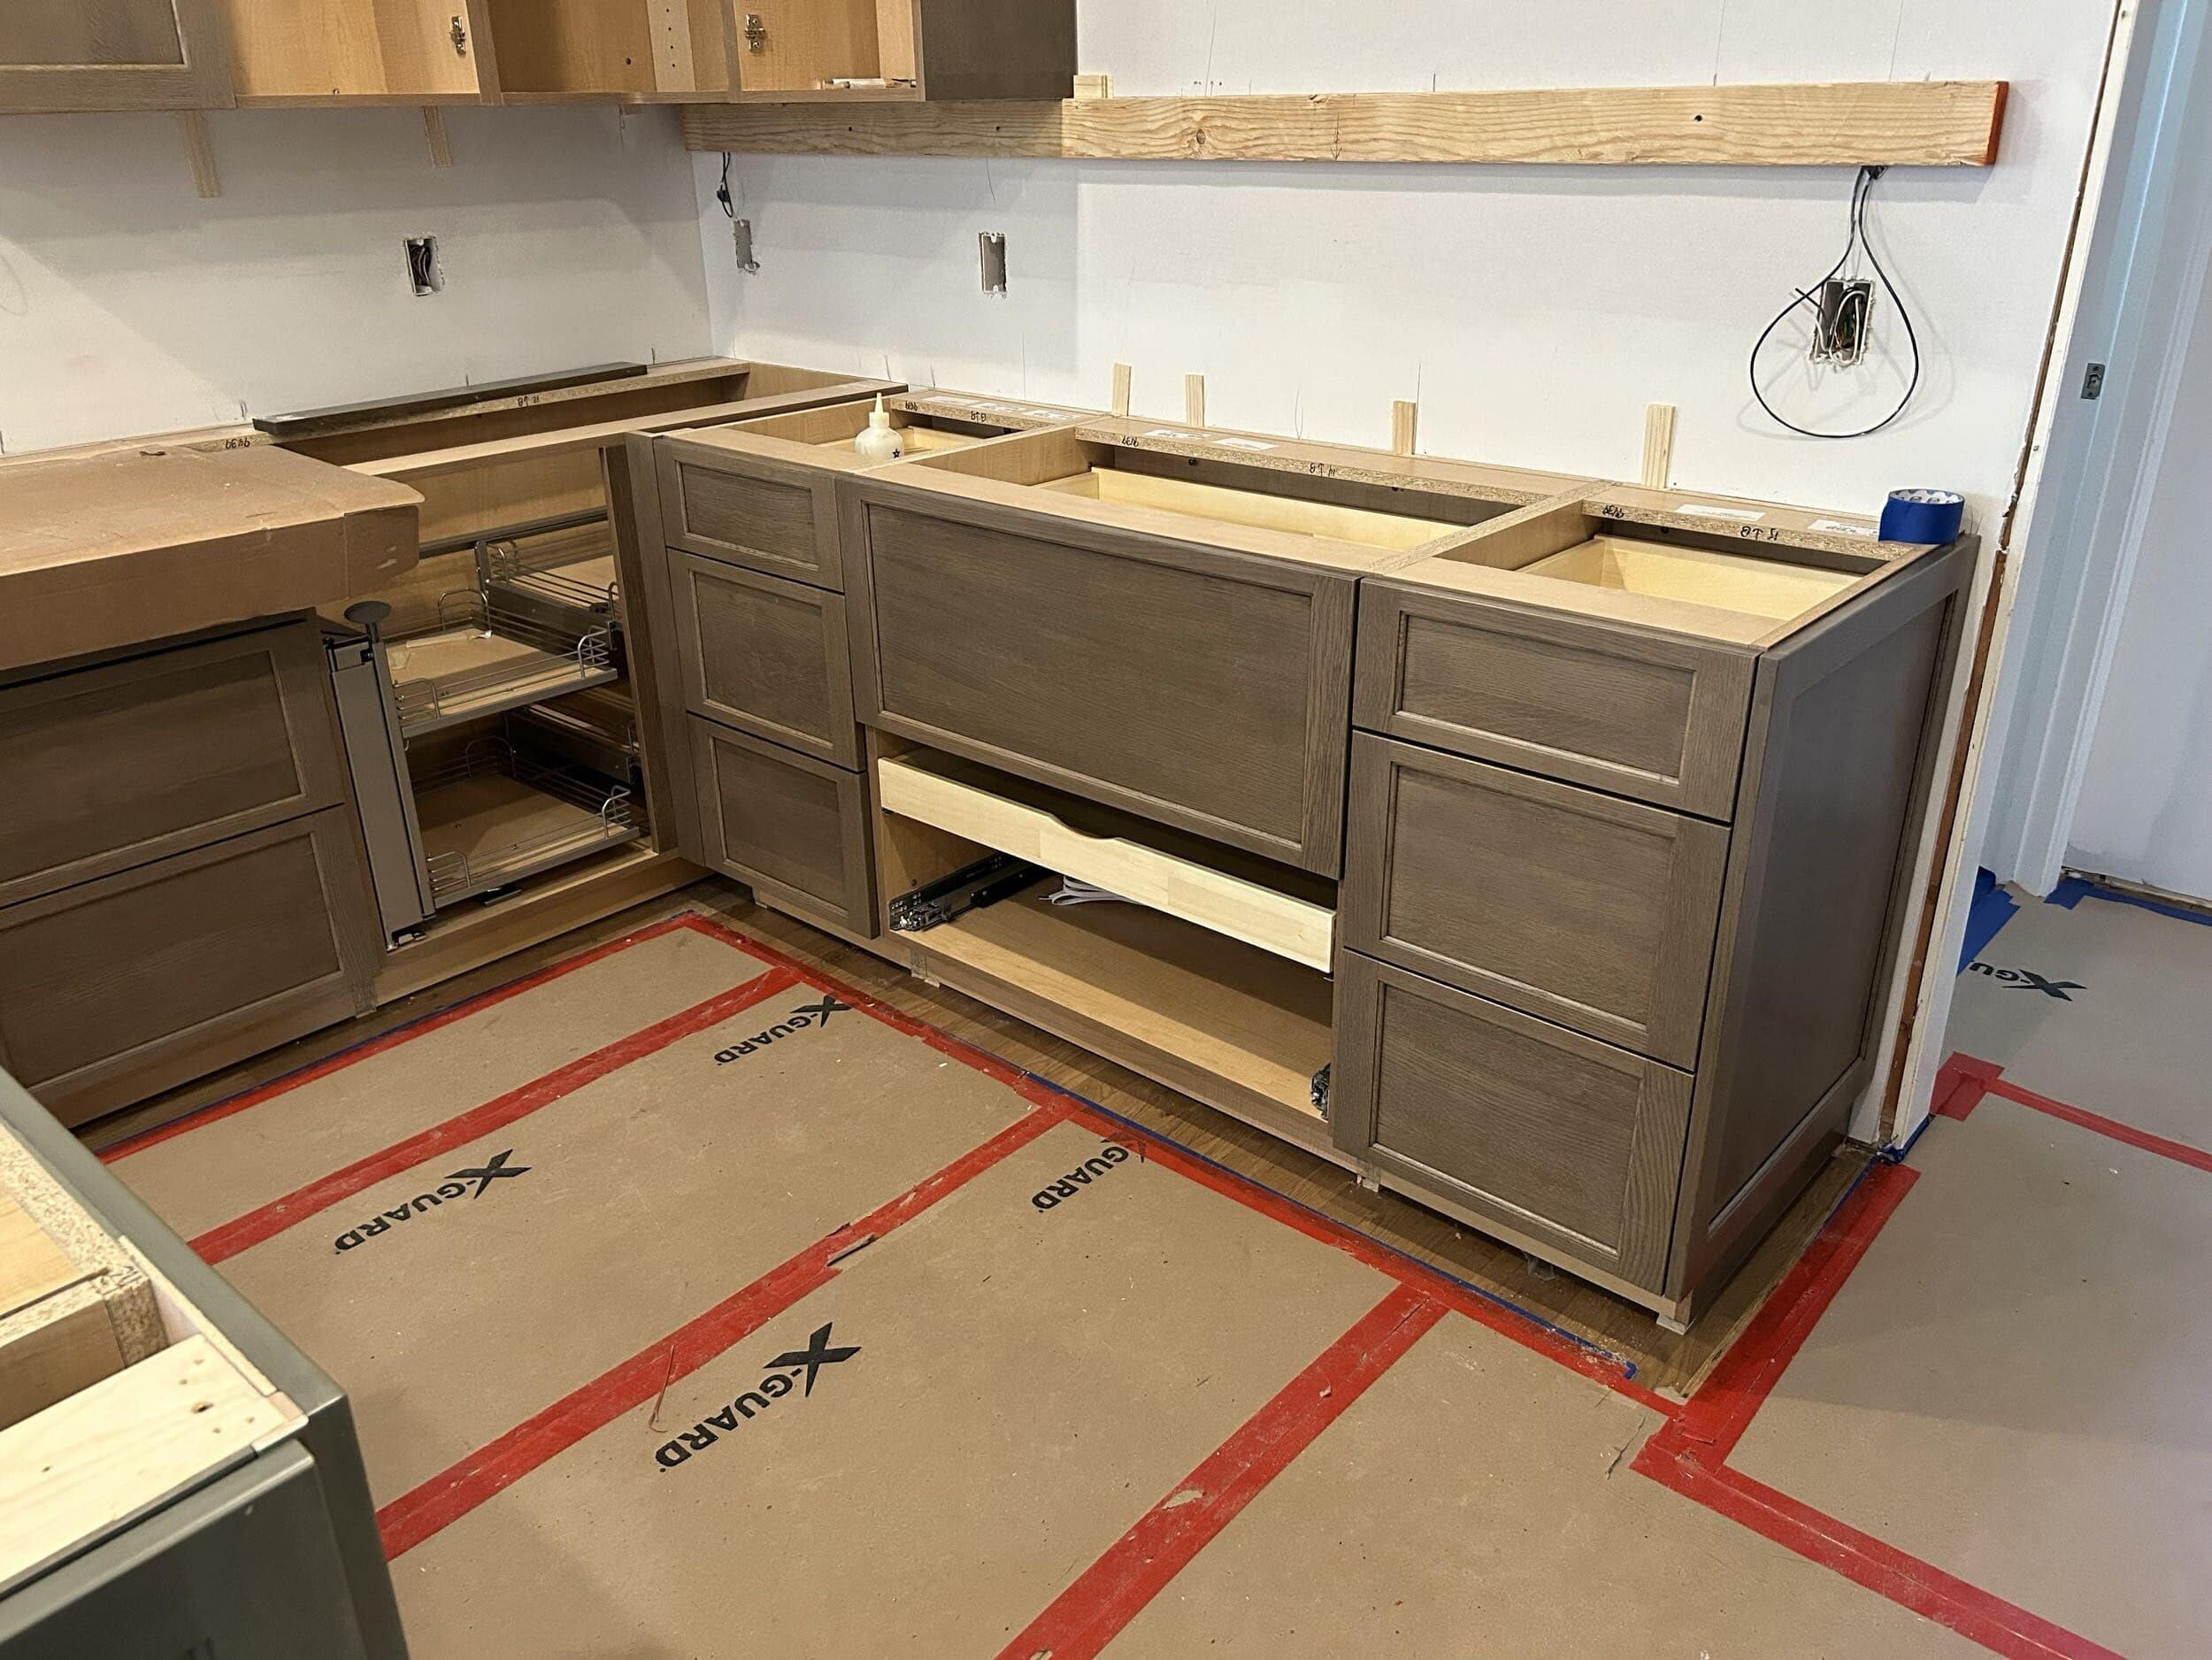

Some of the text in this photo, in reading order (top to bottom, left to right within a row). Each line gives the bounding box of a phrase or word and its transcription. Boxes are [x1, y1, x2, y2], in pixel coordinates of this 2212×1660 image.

[1969, 962, 2088, 1002] X-GU
[714, 994, 852, 1065] X-GUARD
[334, 1149, 532, 1255] X-GUARD
[656, 1322, 862, 1472] X-GUARD
